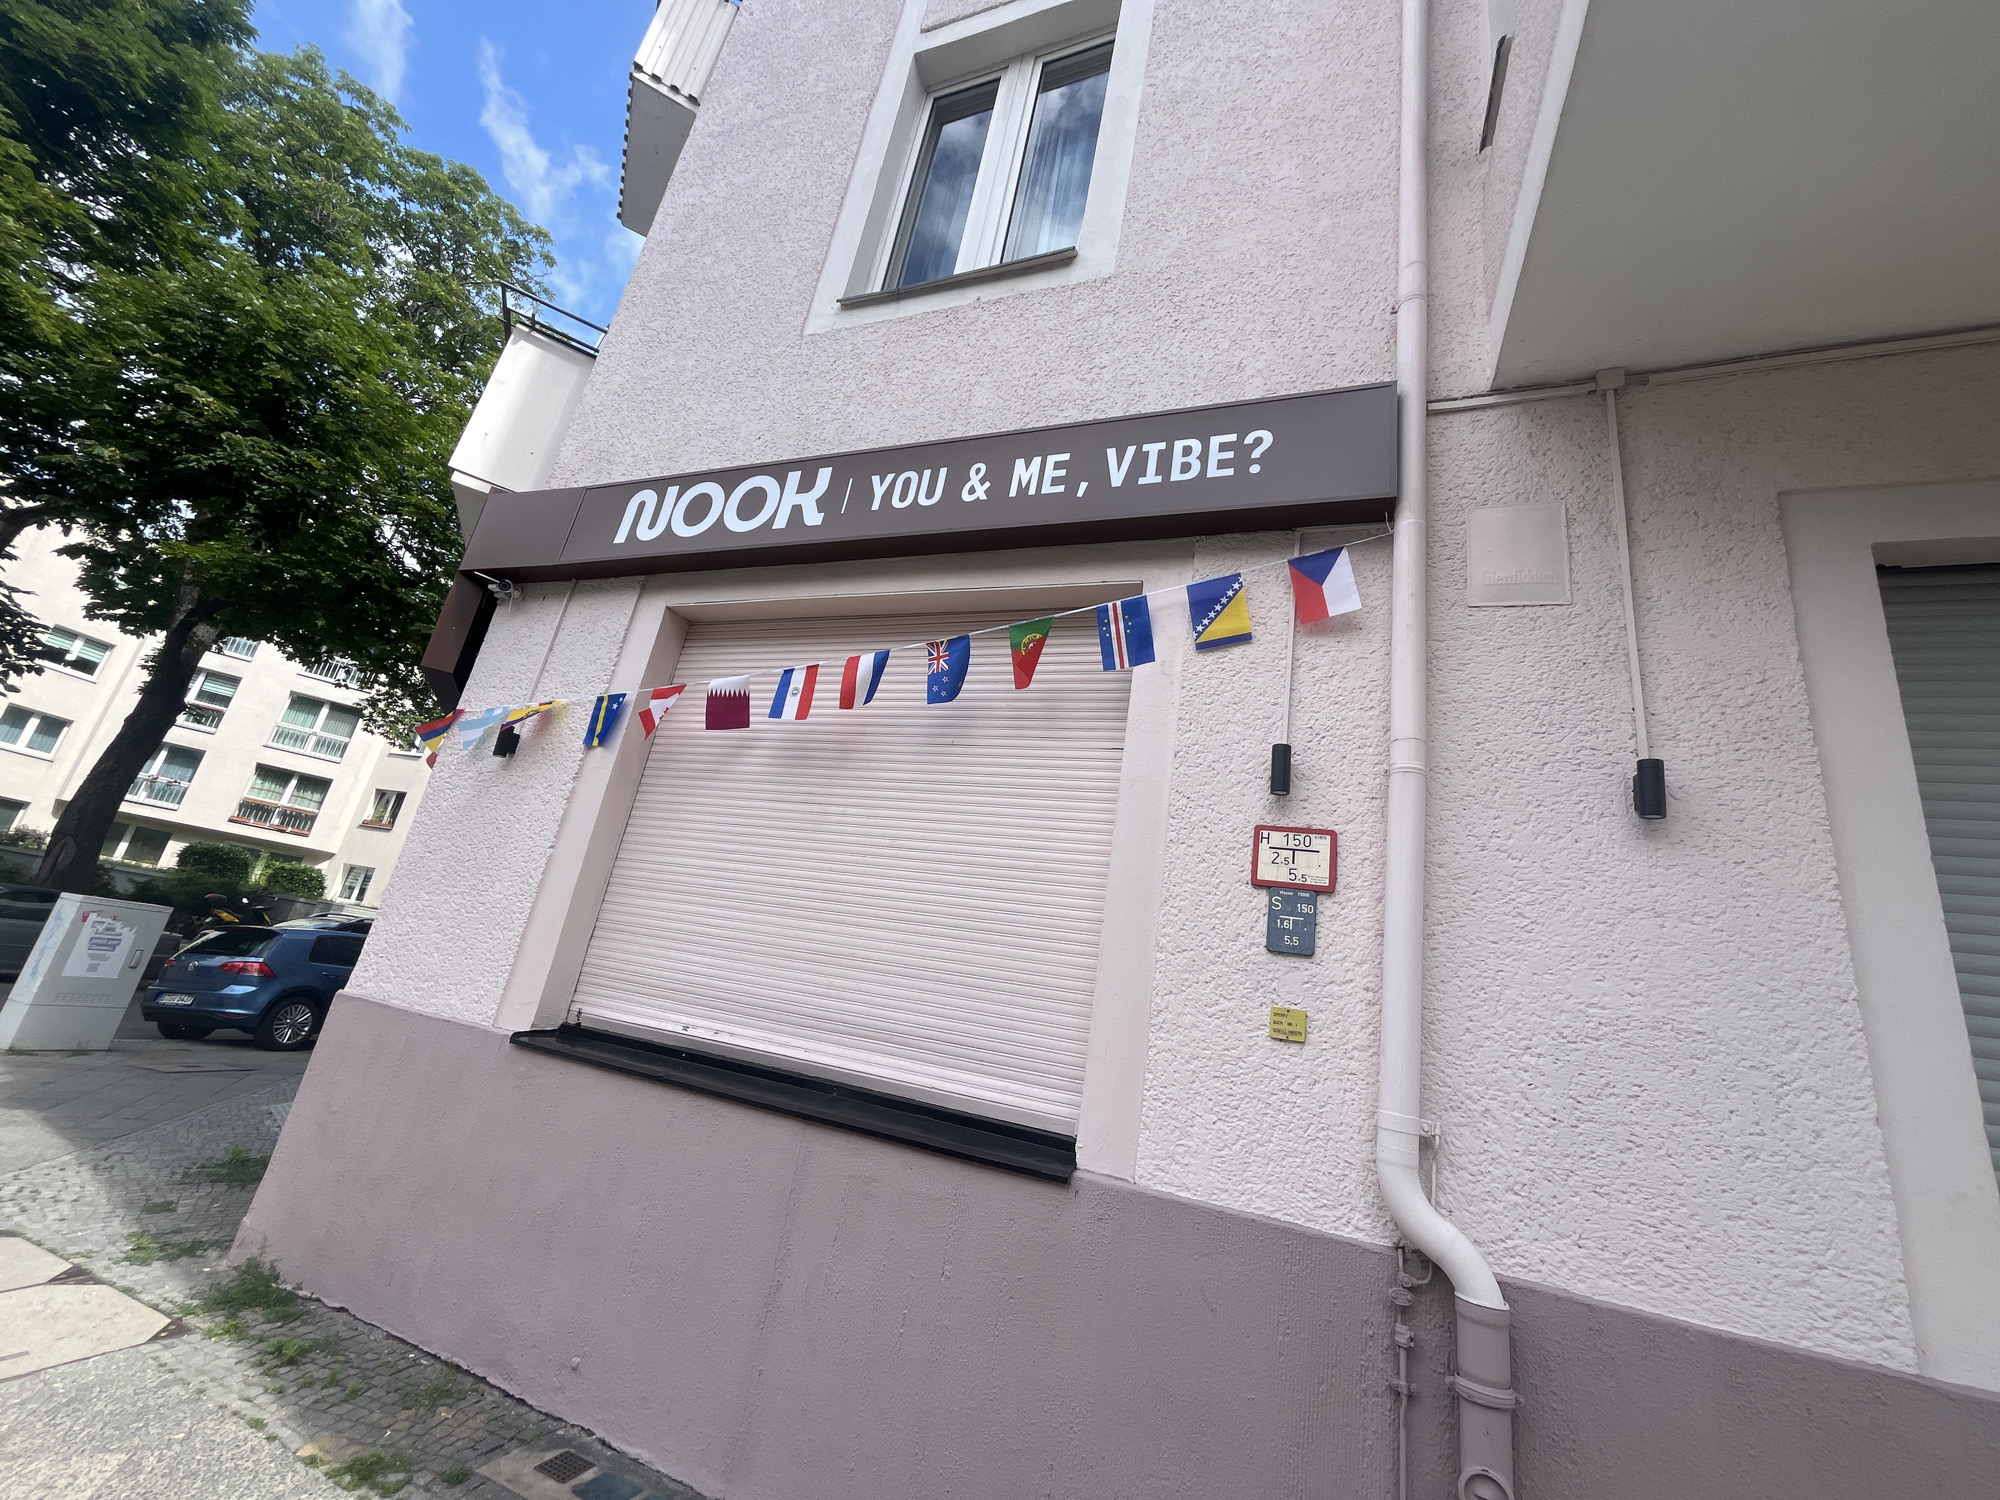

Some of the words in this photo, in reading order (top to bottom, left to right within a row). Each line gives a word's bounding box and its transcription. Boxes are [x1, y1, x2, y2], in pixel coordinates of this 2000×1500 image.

[870, 463, 948, 512] YOU
[961, 462, 990, 501] &
[1009, 452, 1089, 499] ME,
[1106, 429, 1274, 488] VIBE?
[613, 466, 832, 544] NOOK
[1260, 832, 1270, 844] H
[1284, 833, 1312, 847] 150
[1271, 851, 1290, 865] 2.5
[1289, 868, 1307, 882] 5.5
[1271, 896, 1282, 910] S
[1297, 904, 1314, 913] 150
[1276, 919, 1289, 929] 1.6
[1284, 936, 1299, 945] 5.5
